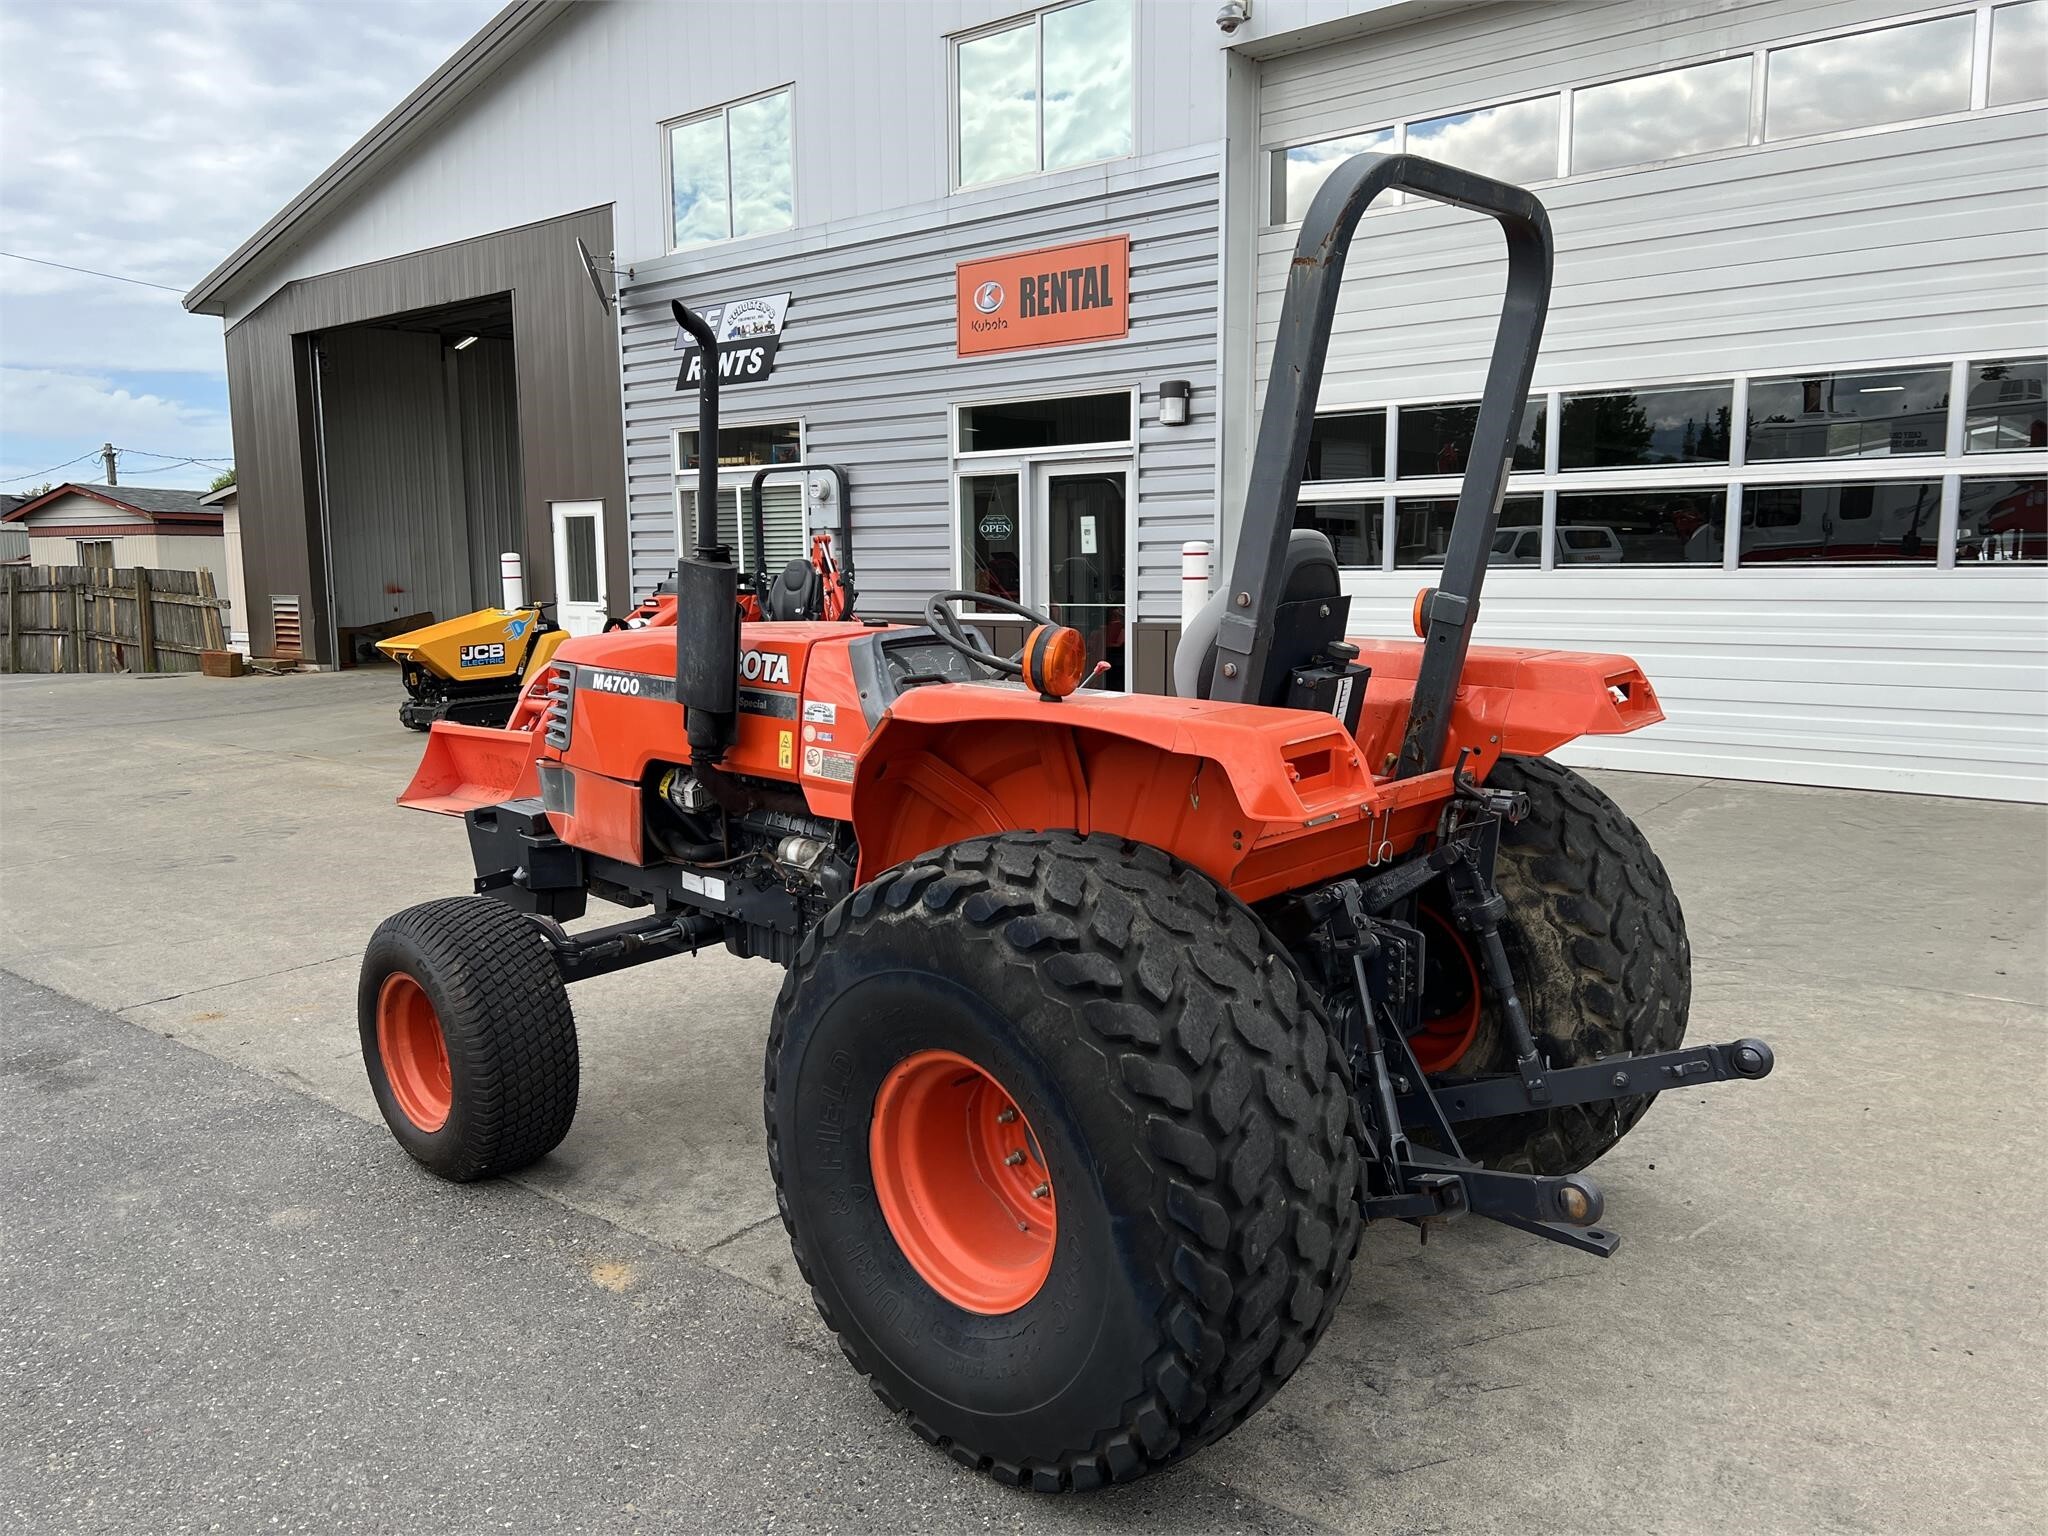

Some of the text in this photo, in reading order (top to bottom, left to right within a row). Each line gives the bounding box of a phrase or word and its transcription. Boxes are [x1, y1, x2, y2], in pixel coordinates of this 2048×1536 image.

[1020, 264, 1113, 318] RENTAL
[971, 317, 1008, 332] Kubota
[686, 347, 764, 382] RNTS
[981, 524, 1010, 533] OPEN
[461, 644, 504, 660] JCB
[461, 657, 504, 667] ELECTRIC
[592, 673, 640, 695] M4700
[740, 696, 767, 710] Special
